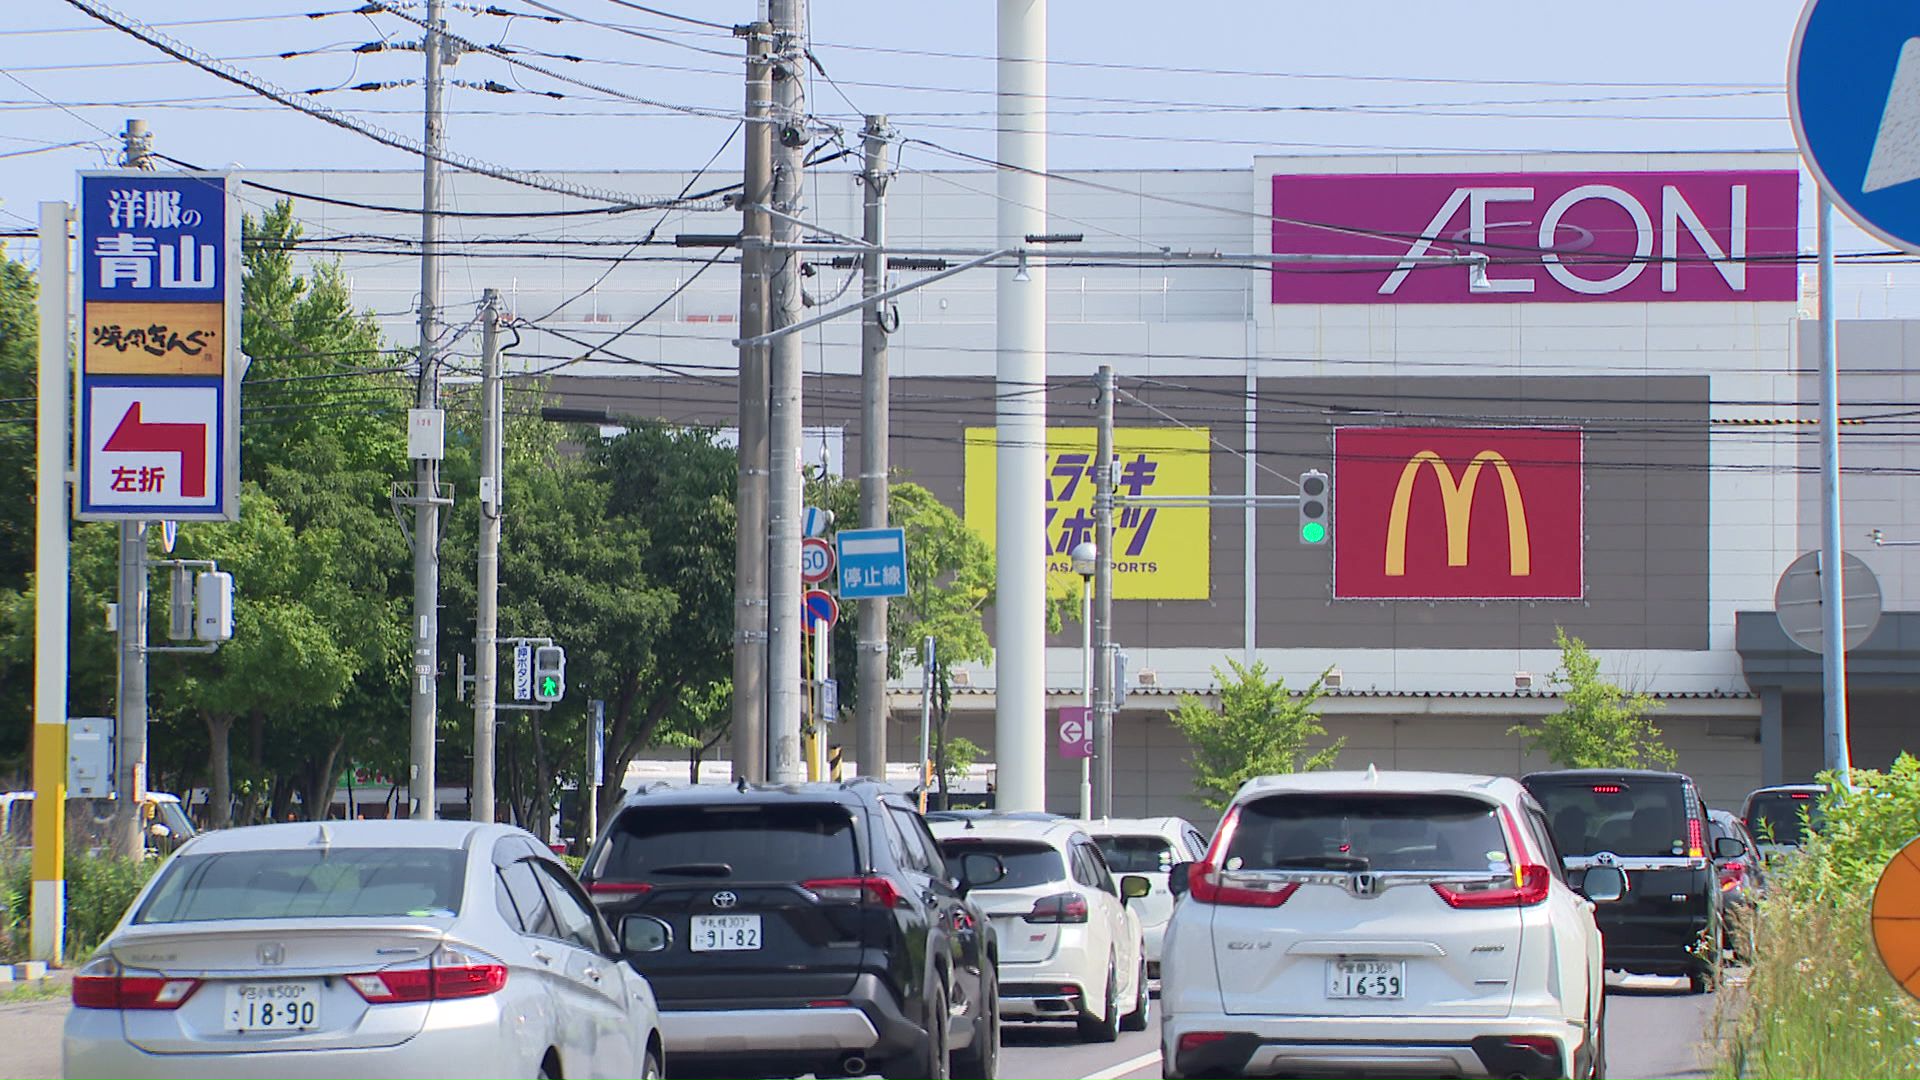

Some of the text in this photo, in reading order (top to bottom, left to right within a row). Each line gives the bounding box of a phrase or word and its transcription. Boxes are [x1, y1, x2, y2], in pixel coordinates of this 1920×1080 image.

[108, 189, 202, 229] 洋服の
[94, 232, 215, 289] 青山
[93, 323, 215, 356] 焼肉きんぐ
[110, 466, 166, 493] 左折
[803, 550, 825, 570] 50
[843, 565, 902, 588] 停止線
[517, 646, 529, 699] 押ボタン式
[707, 929, 757, 948] 91-82
[1346, 976, 1400, 996] 16-59
[249, 1002, 314, 1026] 18-90
